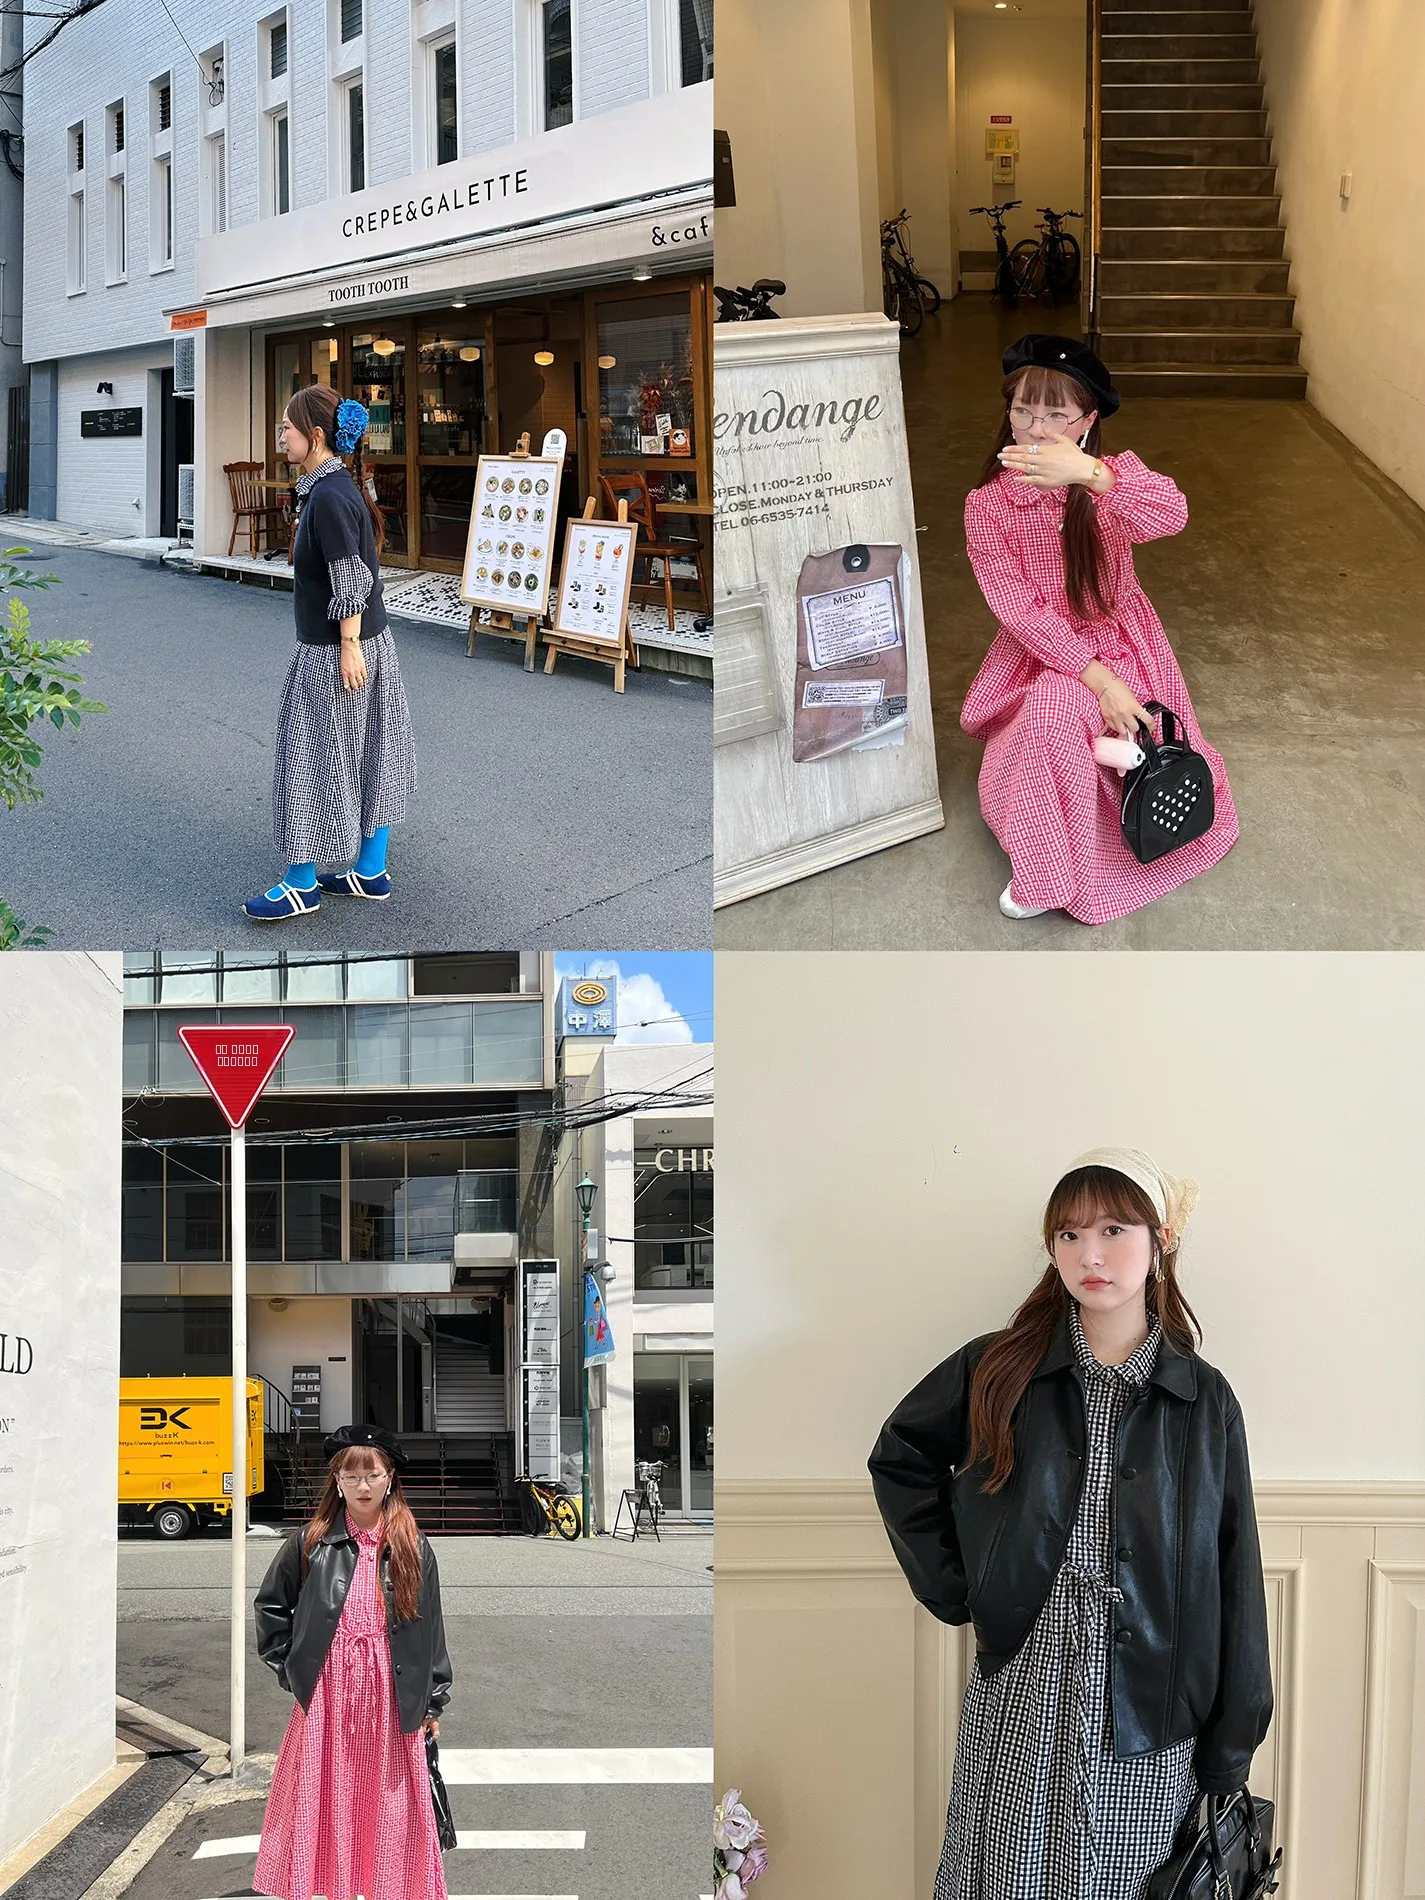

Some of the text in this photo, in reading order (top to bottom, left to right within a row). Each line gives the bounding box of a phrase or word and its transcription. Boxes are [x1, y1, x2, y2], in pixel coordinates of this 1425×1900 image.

[342, 169, 528, 238] CREPE&GALETTE
[328, 276, 408, 302] TOOTH TOOTH
[773, 436, 804, 450] beyond
[814, 488, 824, 498] &
[826, 476, 894, 497] THURSDAY
[834, 590, 866, 605] MENU
